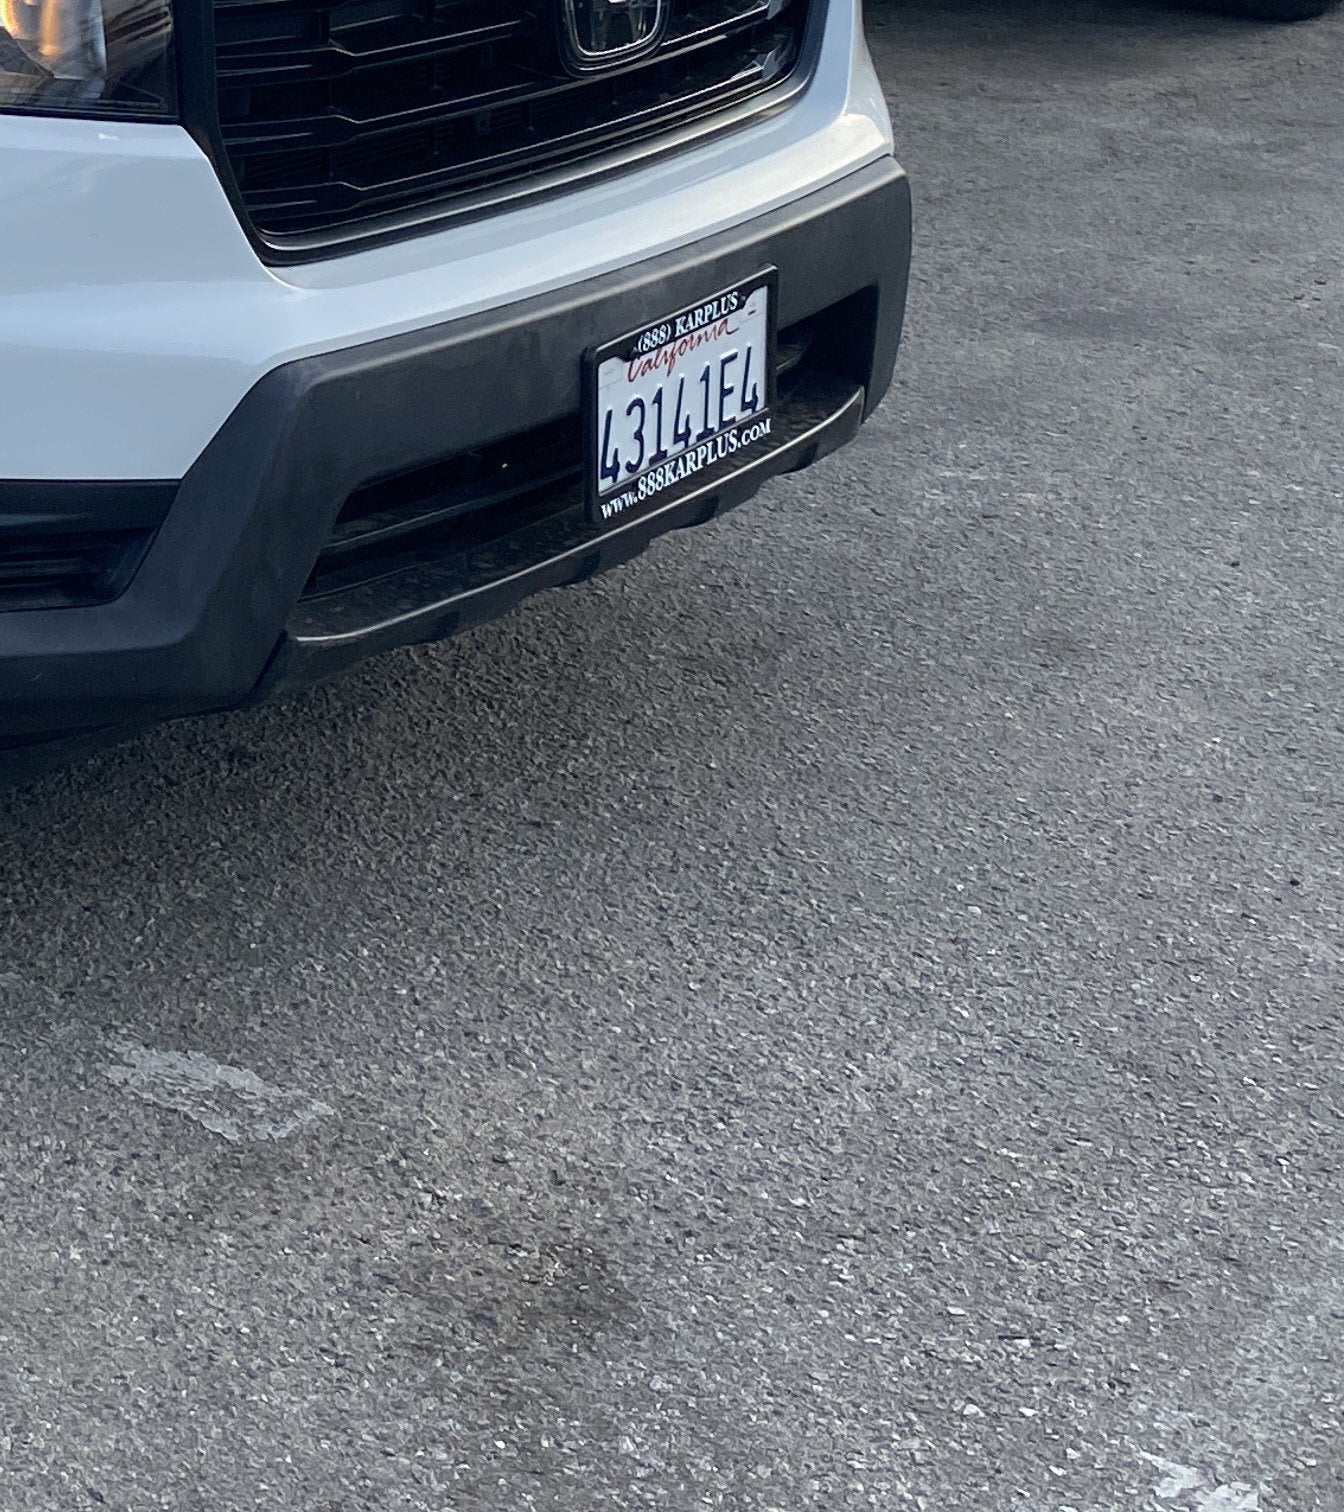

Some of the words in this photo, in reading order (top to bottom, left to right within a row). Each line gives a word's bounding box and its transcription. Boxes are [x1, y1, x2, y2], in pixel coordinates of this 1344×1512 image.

[675, 291, 739, 338] KARPLUS
[626, 317, 740, 383] California
[600, 344, 759, 484] 43141E4
